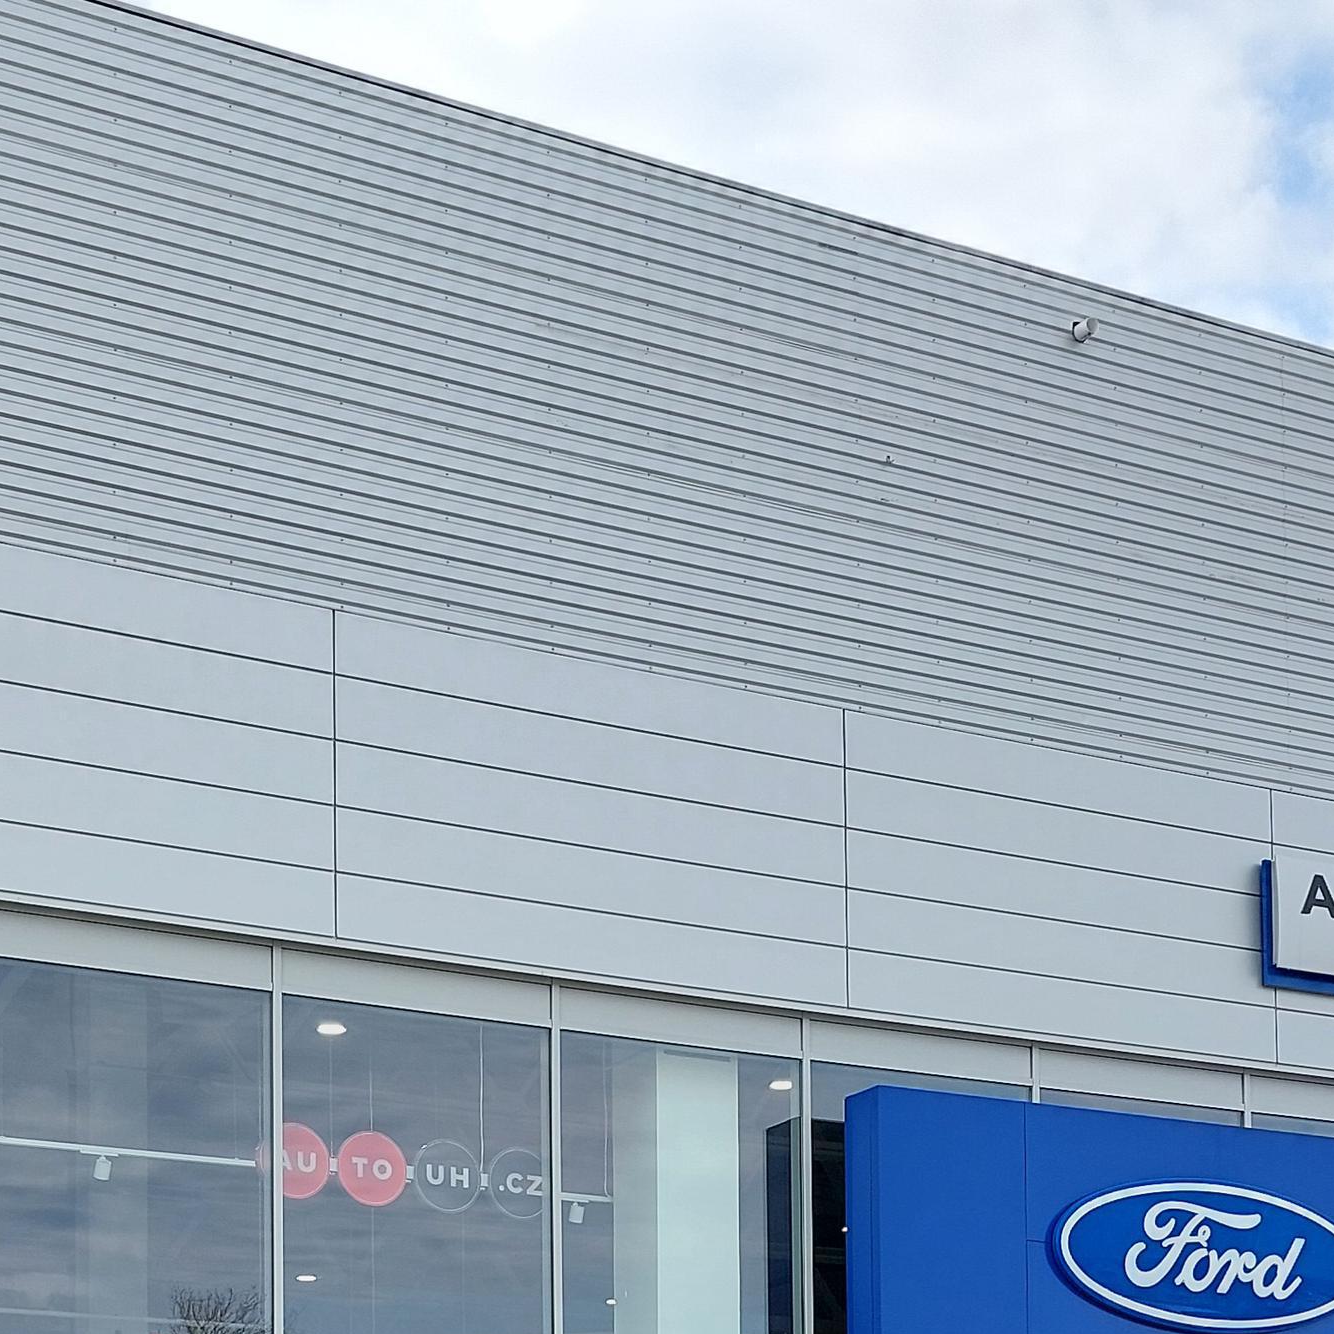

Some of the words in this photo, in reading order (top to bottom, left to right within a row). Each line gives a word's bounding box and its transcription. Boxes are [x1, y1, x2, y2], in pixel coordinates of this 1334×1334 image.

[352, 1156, 393, 1180] TO
[426, 1163, 469, 1189] UH
[498, 1172, 543, 1197] .CZ
[1125, 1200, 1306, 1300] Ford
